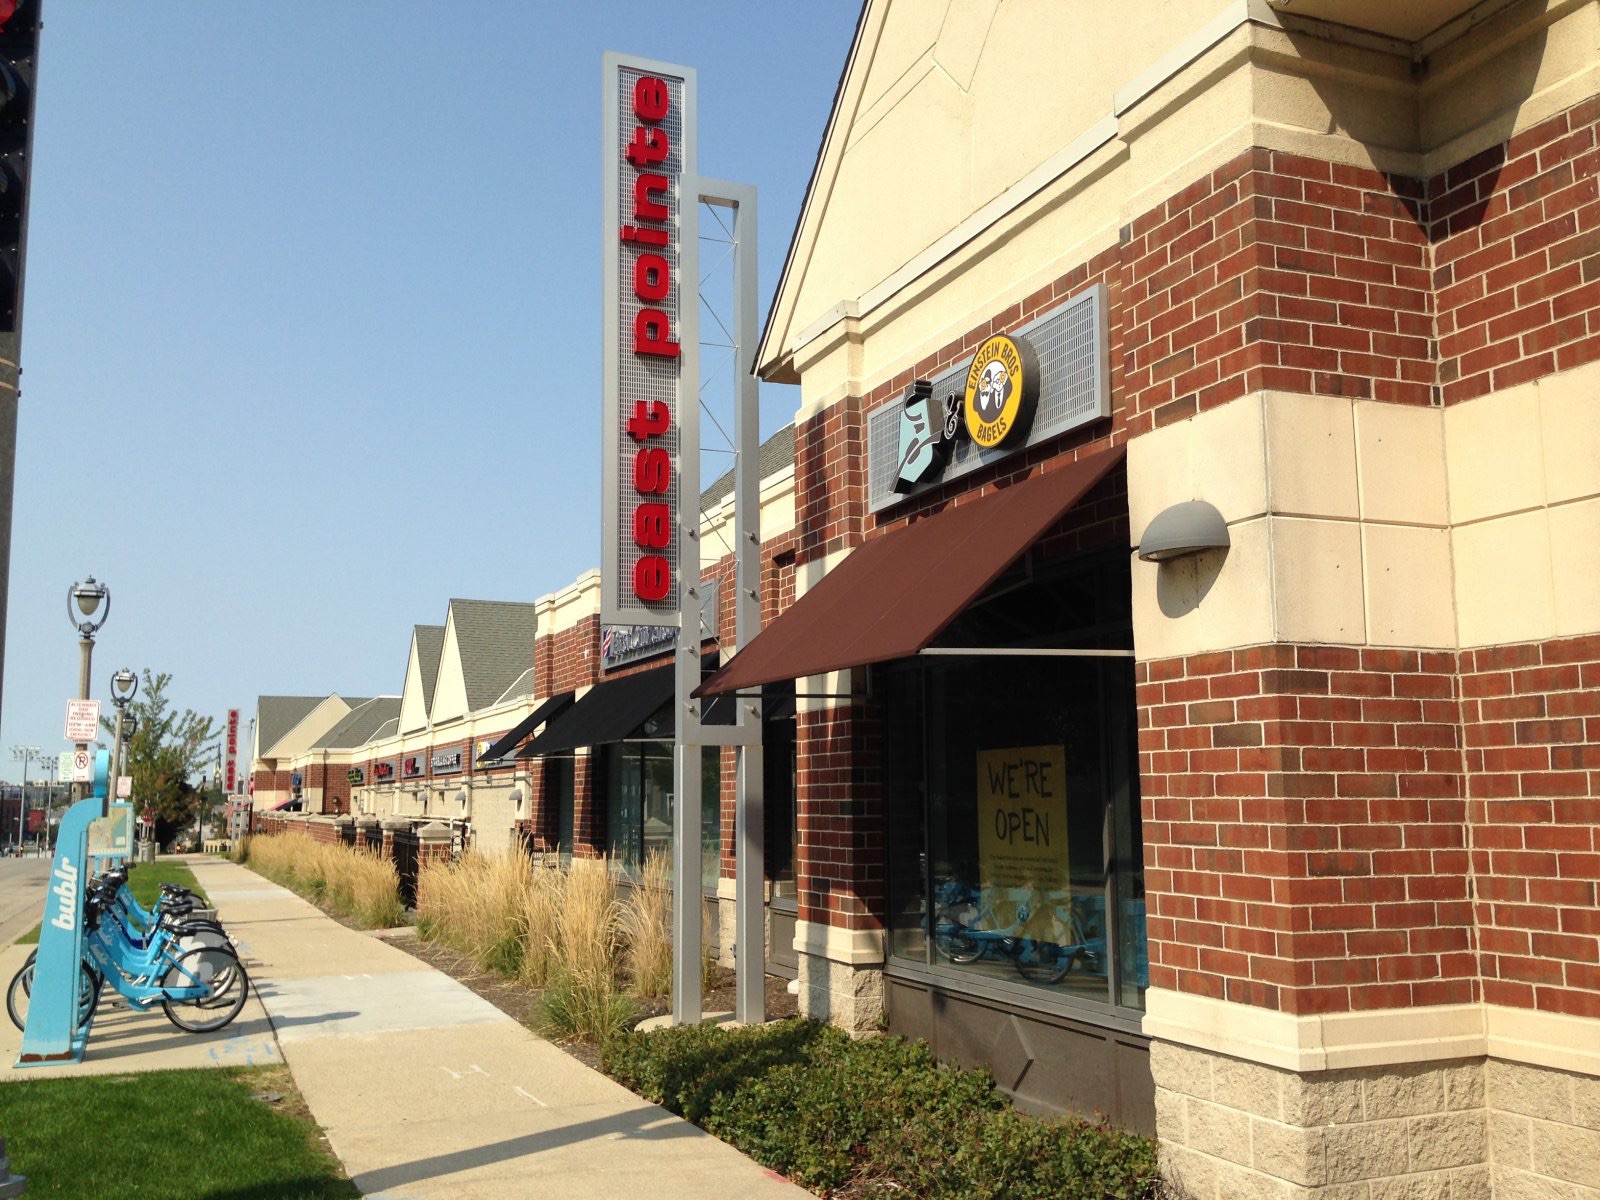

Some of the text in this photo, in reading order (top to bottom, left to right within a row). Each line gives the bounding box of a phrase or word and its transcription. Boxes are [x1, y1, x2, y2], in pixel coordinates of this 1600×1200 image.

[621, 75, 680, 357] pointe
[968, 341, 1019, 390] EINSTEIN BROS
[976, 417, 1007, 443] BAGELS
[627, 400, 670, 602] east
[987, 758, 1053, 799] WE'RE
[994, 807, 1050, 848] OPEN
[51, 856, 78, 931] bublr
